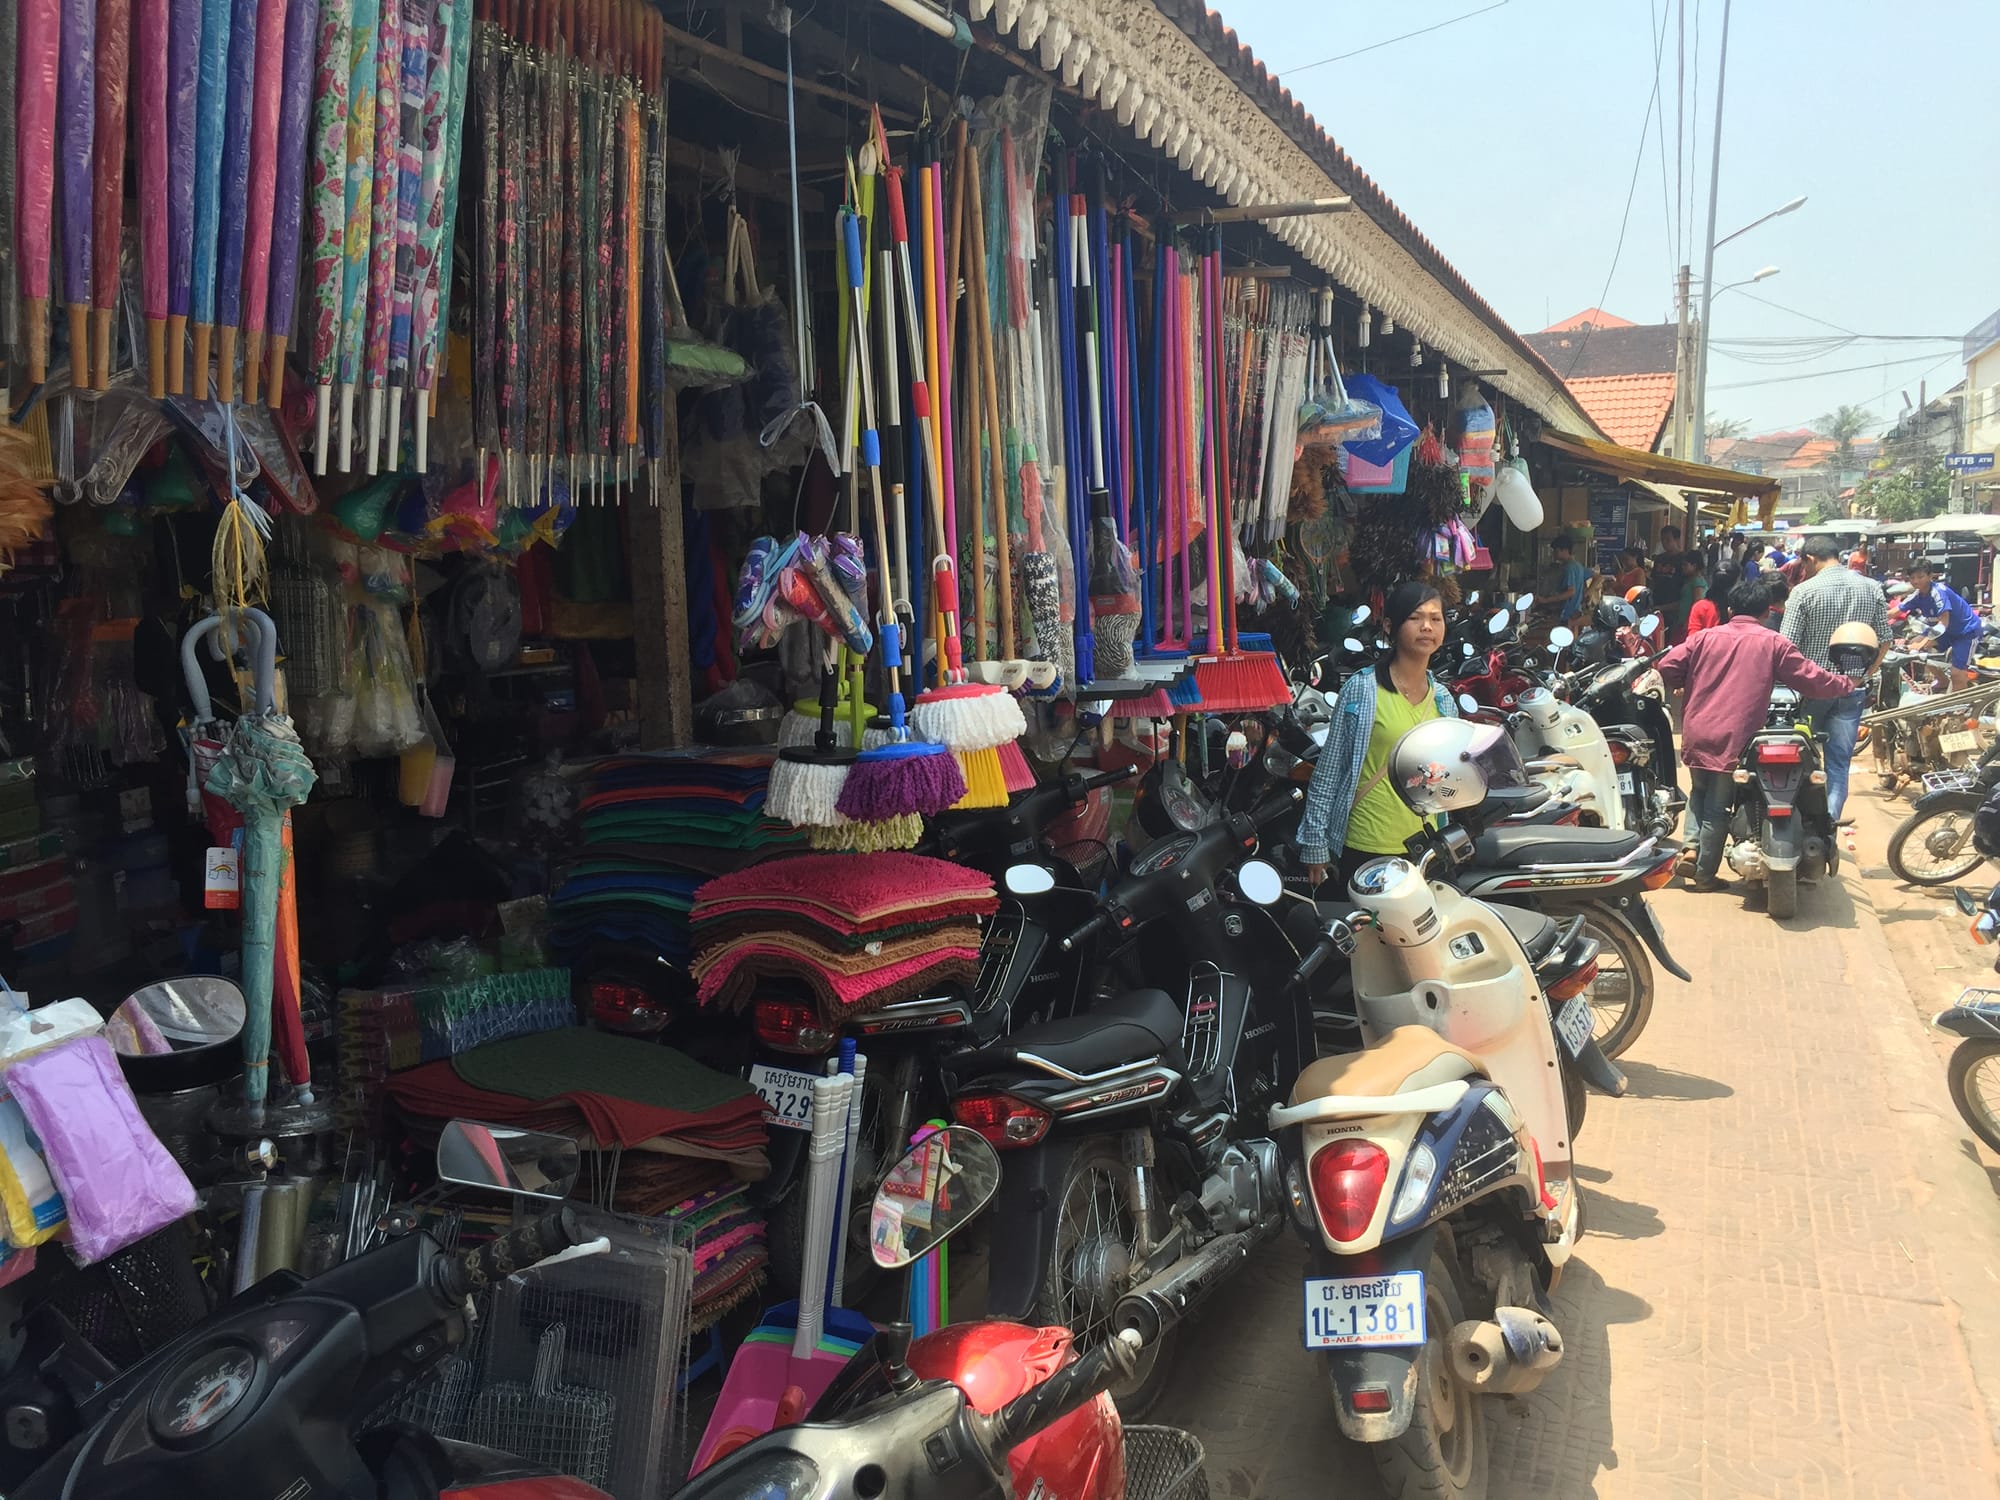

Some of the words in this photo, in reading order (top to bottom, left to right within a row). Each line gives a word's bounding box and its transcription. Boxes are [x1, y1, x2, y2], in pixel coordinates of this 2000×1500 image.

[1954, 456, 1974, 465] FTB
[1244, 1022, 1277, 1039] HONDA
[1327, 1125, 1364, 1135] HONDA
[1322, 1333, 1405, 1344] B-MEANCHEY
